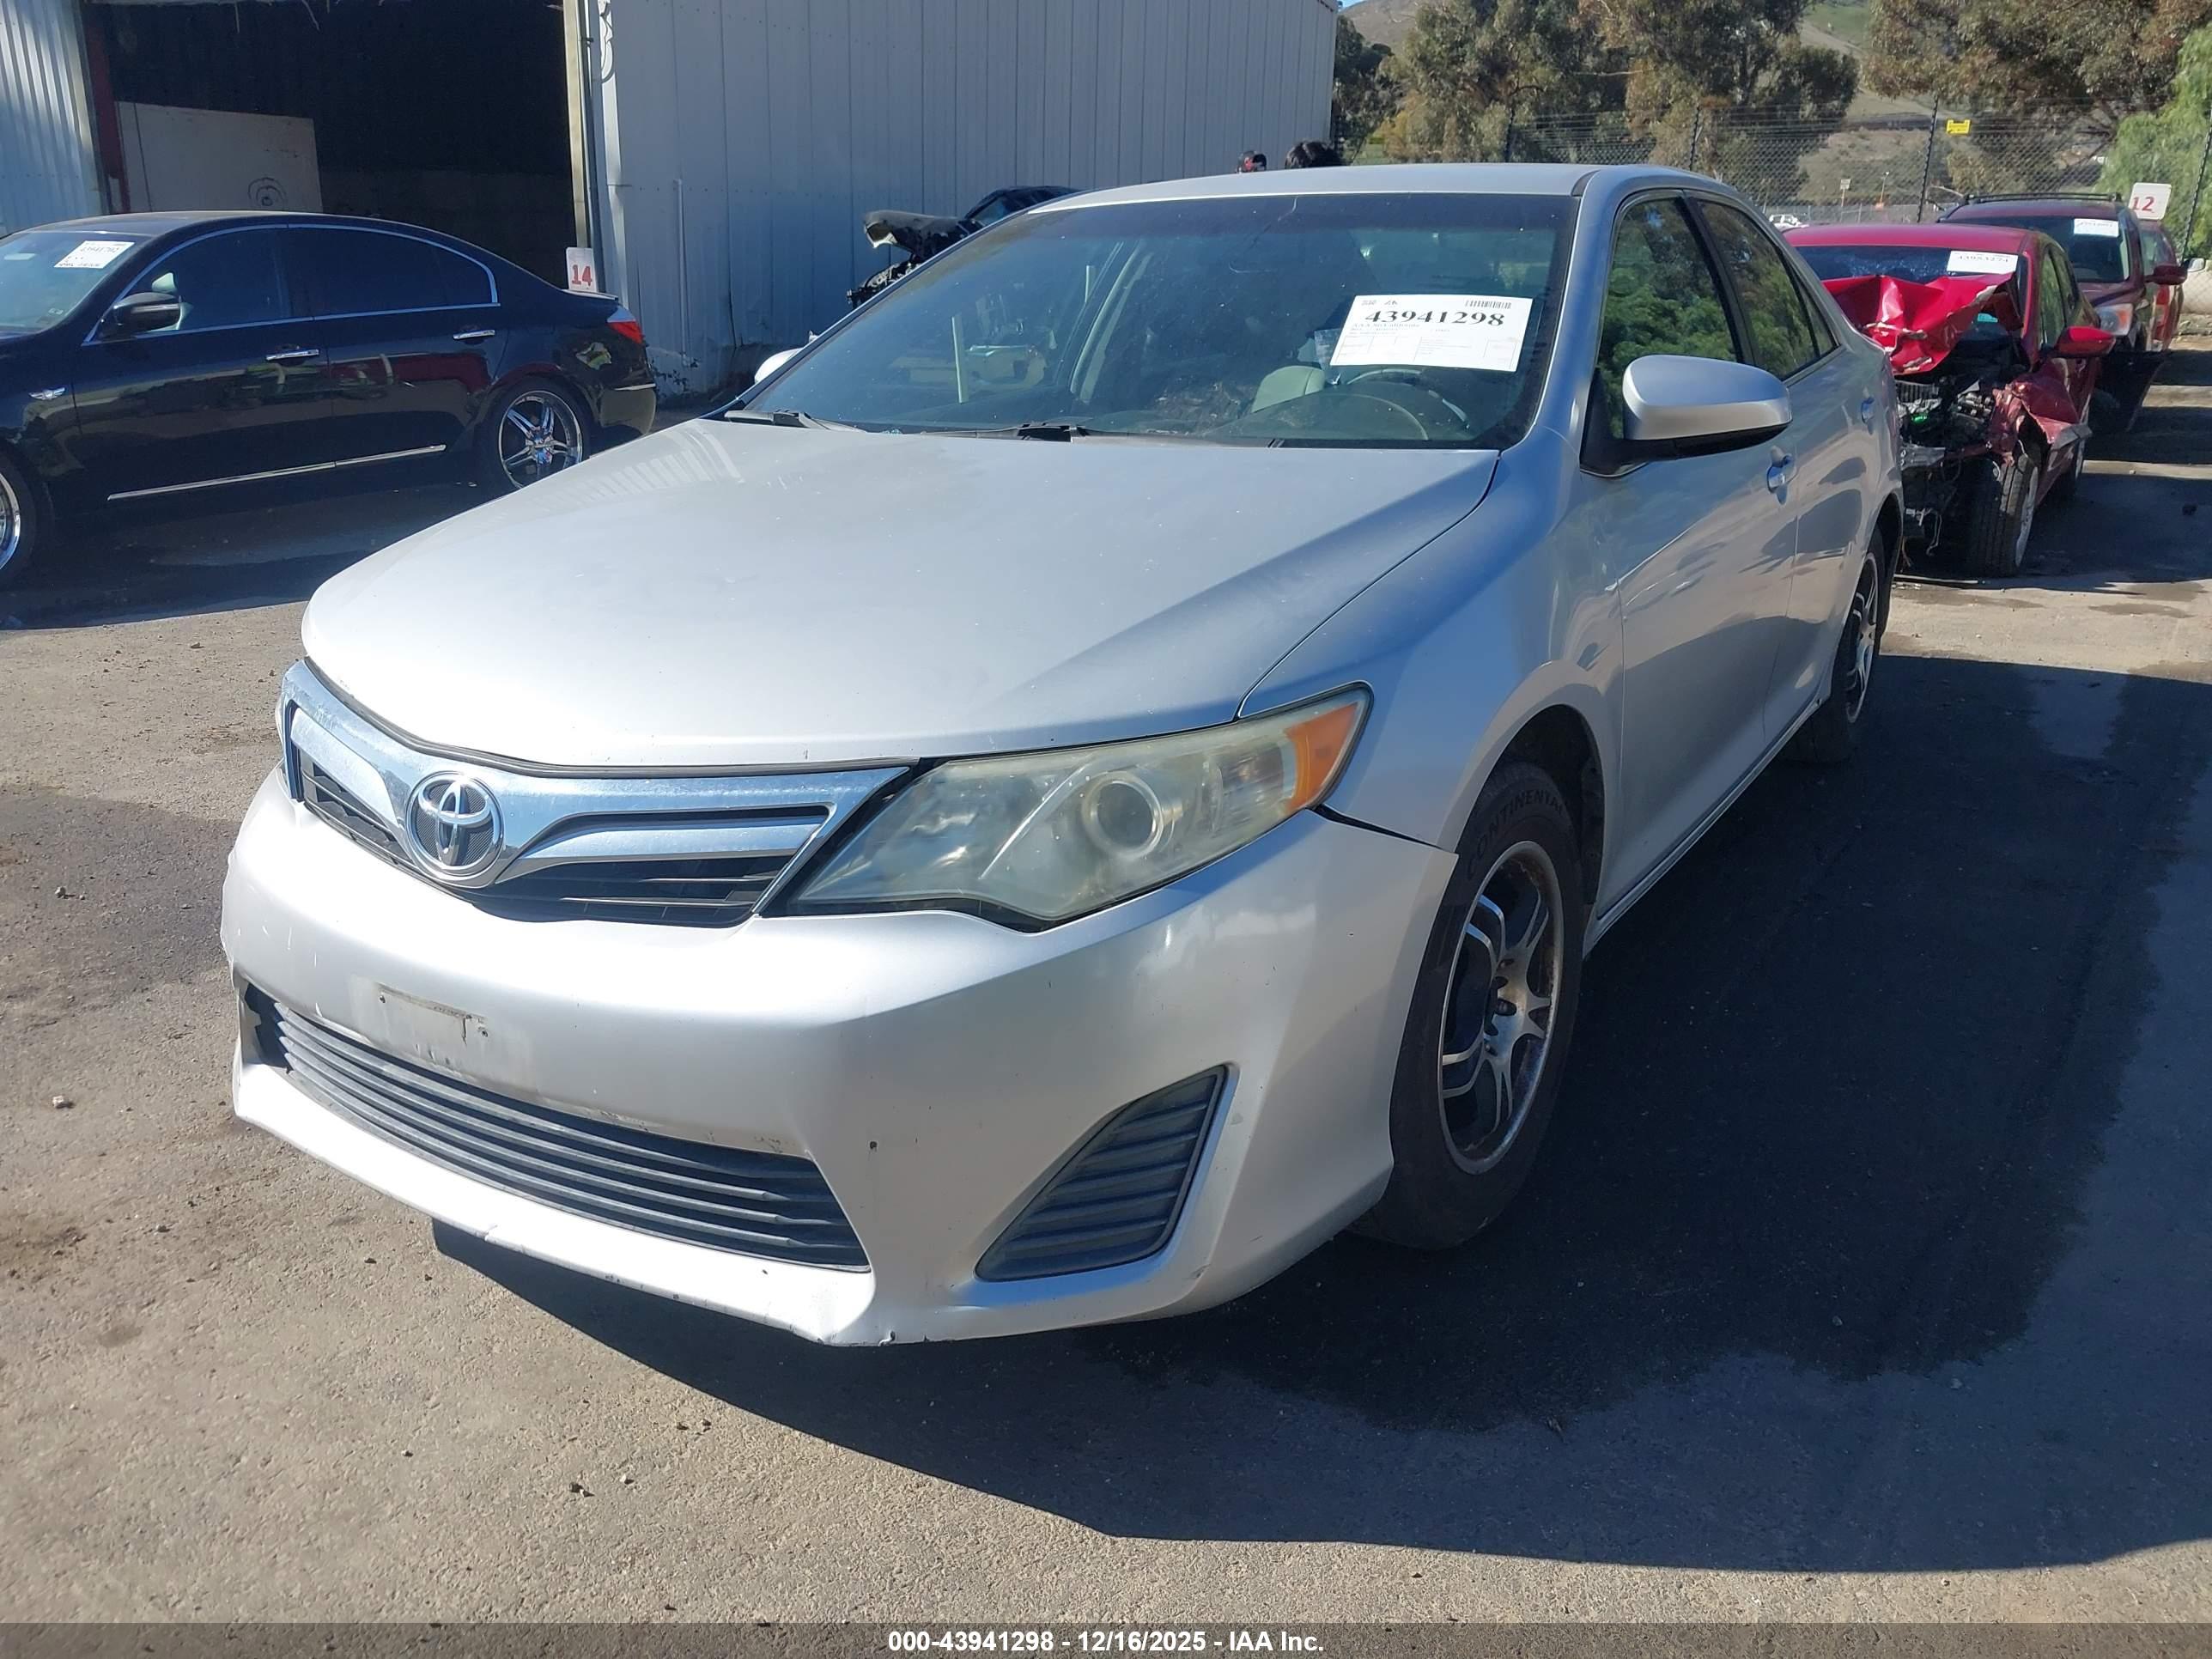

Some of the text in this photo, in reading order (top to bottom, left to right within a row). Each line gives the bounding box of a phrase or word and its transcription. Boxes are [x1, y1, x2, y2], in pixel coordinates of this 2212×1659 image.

[2132, 196, 2154, 212] 12
[571, 264, 592, 286] 14
[1365, 310, 1505, 326] 43941298
